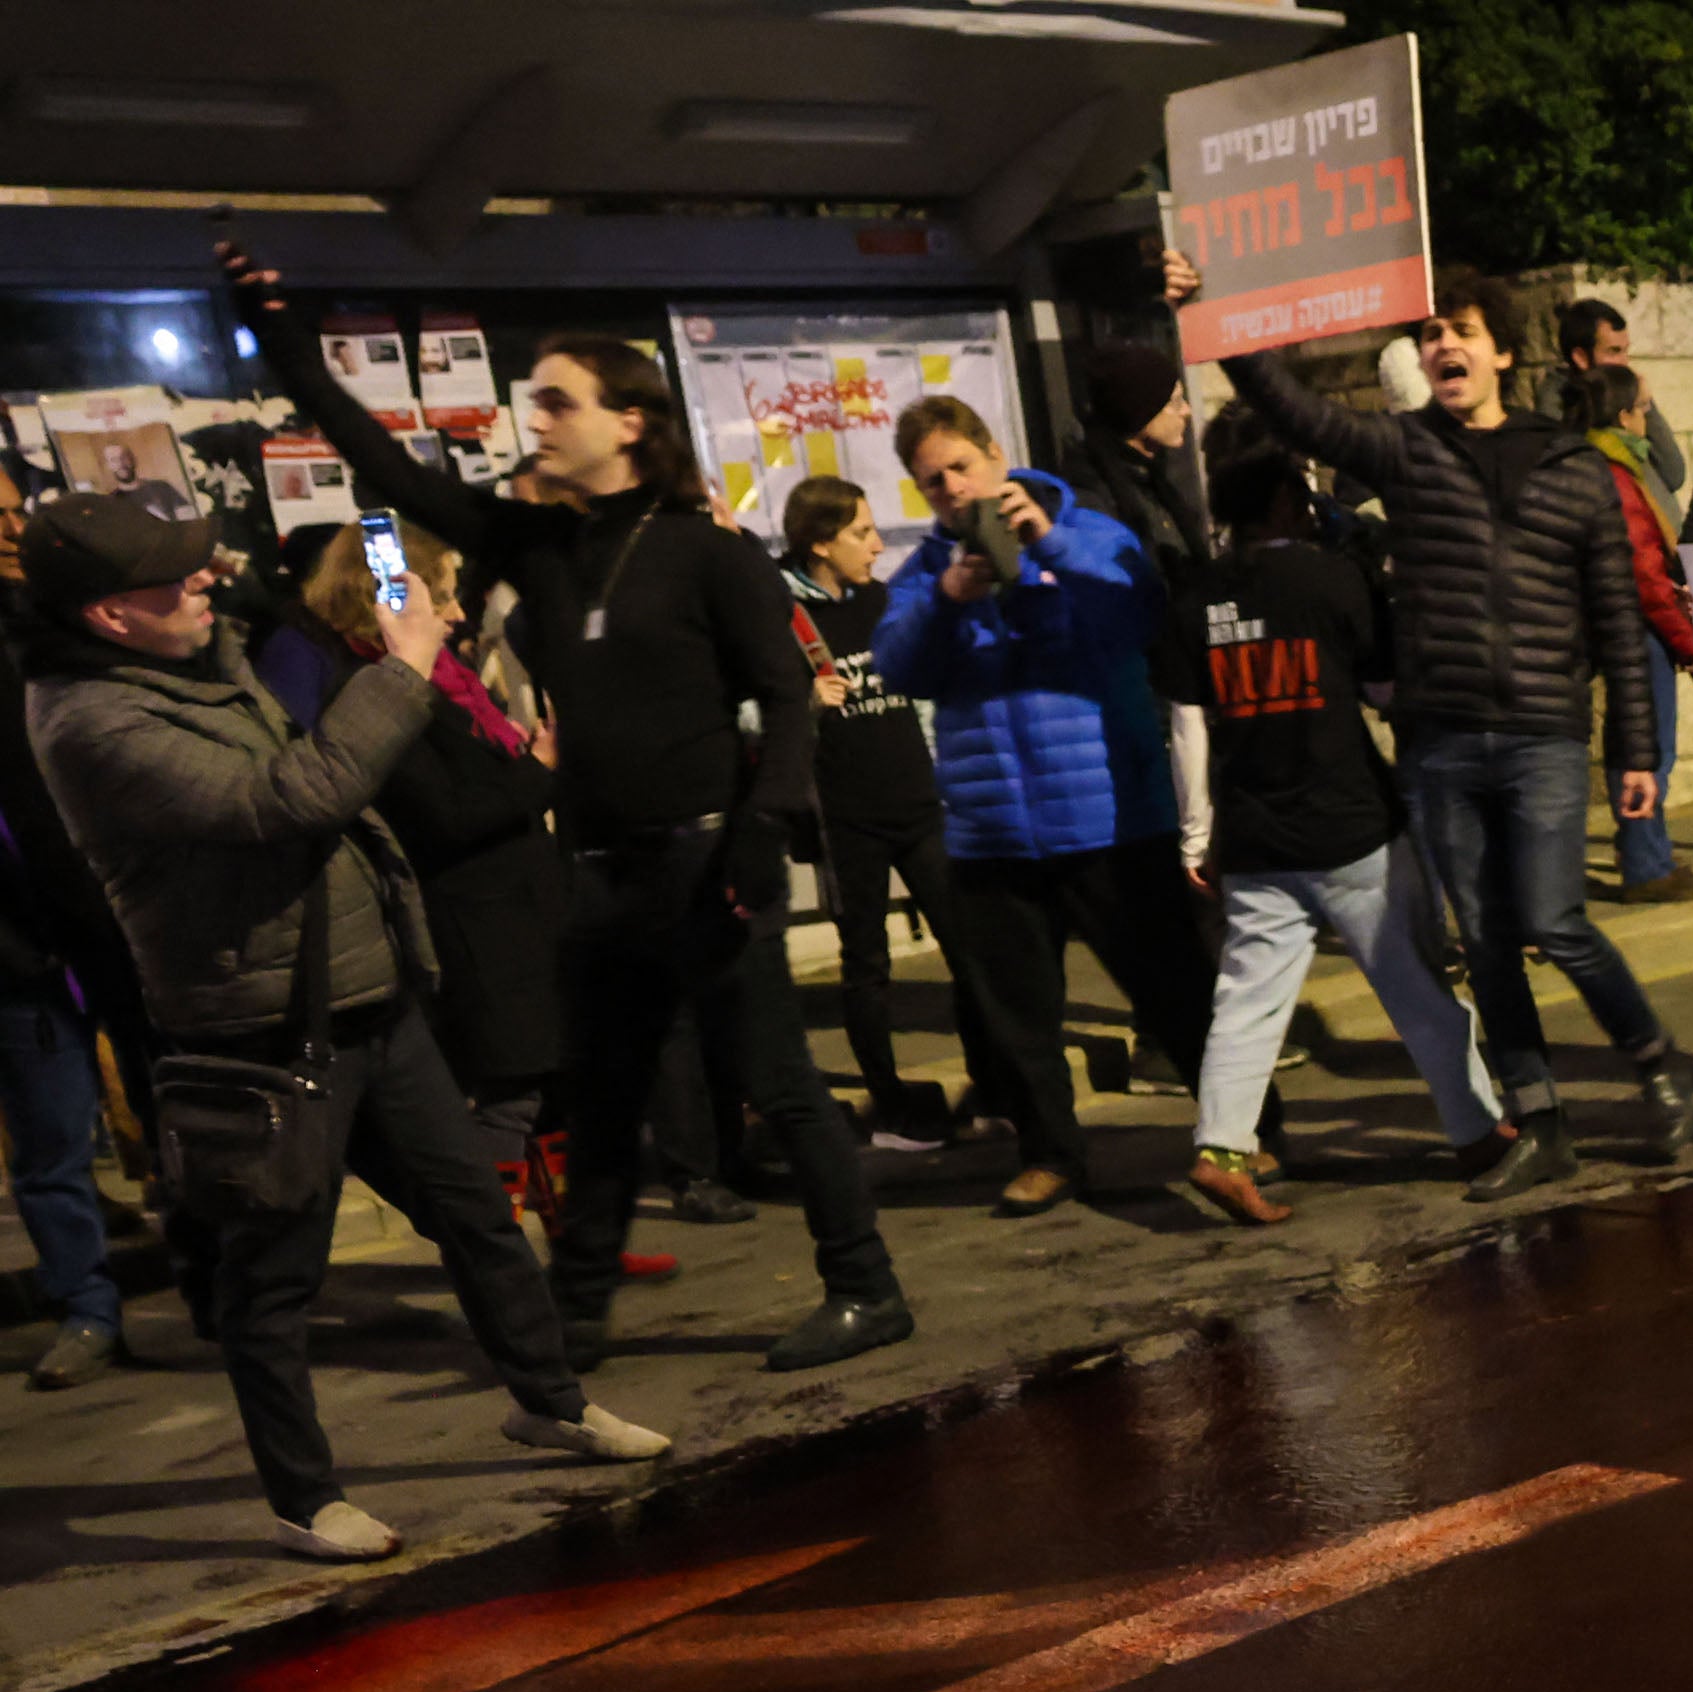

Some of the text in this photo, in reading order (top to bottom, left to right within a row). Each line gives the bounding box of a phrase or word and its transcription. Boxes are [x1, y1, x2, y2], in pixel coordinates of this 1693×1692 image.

[1201, 97, 1378, 174] פדיון שבויים
[1181, 156, 1412, 266] בכל מחיר
